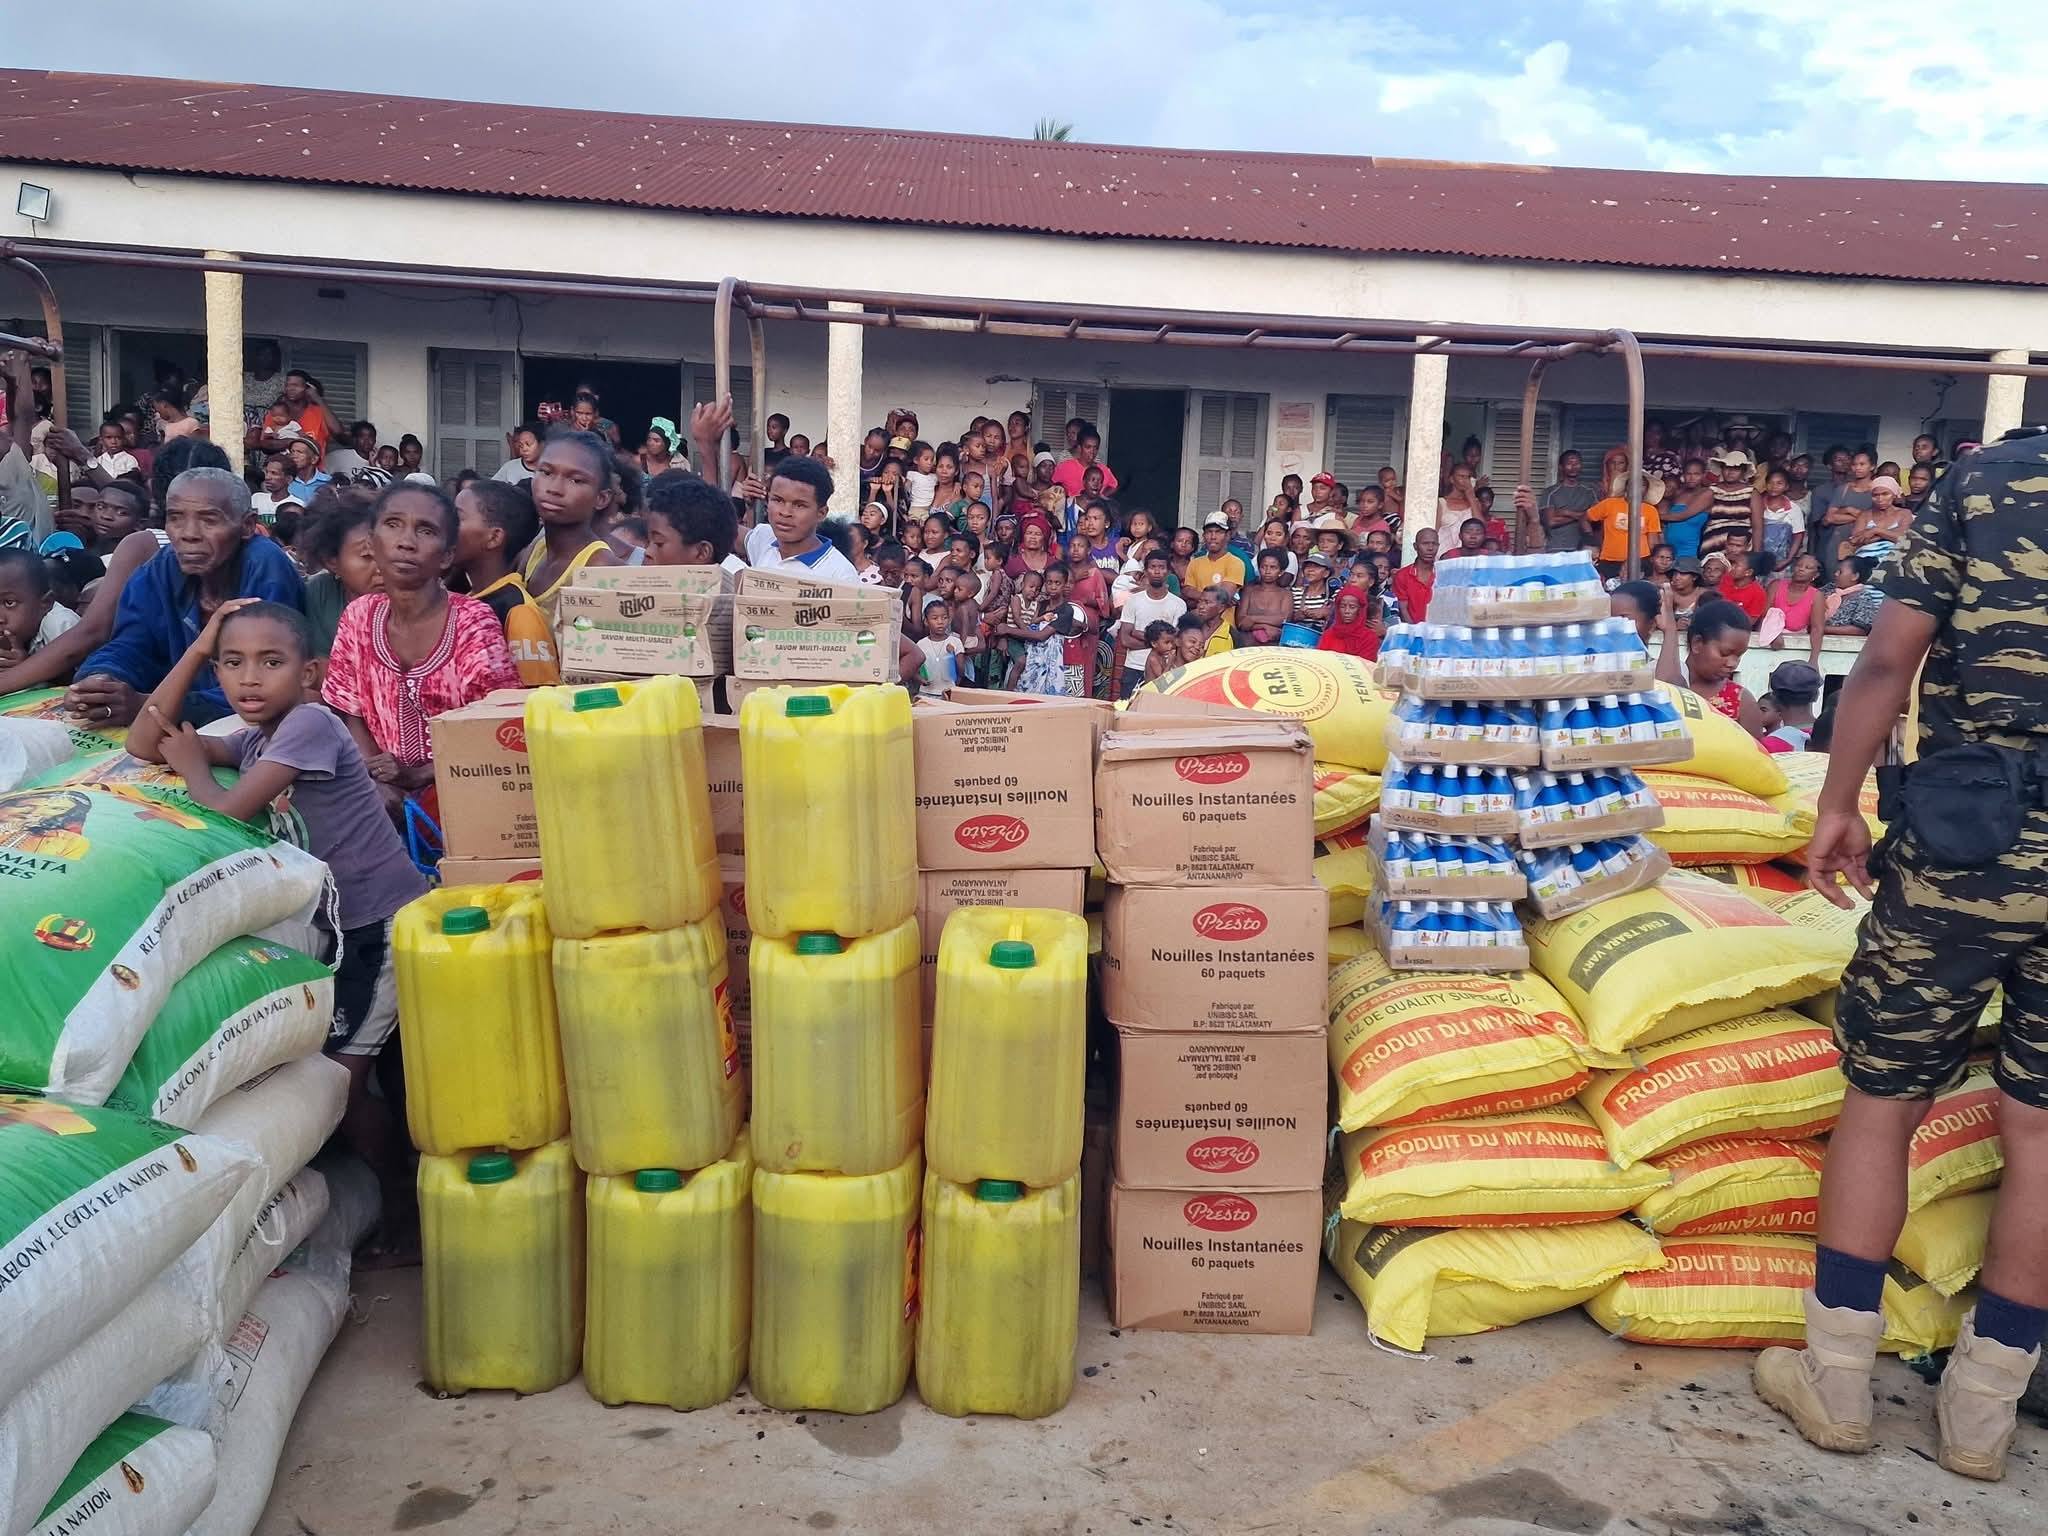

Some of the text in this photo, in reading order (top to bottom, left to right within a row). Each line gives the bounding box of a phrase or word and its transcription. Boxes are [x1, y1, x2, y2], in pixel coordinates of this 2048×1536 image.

[754, 580, 766, 588] 36
[564, 596, 594, 606] 36 Mx
[746, 607, 775, 616] 36 Mx
[601, 633, 624, 642] SAVON
[768, 630, 811, 642] BARRE
[955, 716, 1012, 727] ANTANANARIVO
[944, 728, 990, 737] TALATAMATY
[960, 737, 979, 745] SARL
[449, 763, 512, 779] Nouilles
[1179, 756, 1244, 782] Presto
[501, 781, 516, 792] 60
[954, 775, 1018, 787] 60 paquets
[1007, 789, 1068, 804] Nouilles
[1132, 791, 1297, 807] Nouilles Instantanées
[1657, 790, 1681, 801] DU
[1182, 811, 1247, 824] 60 paquets
[962, 816, 1025, 842] Presto
[1225, 846, 1237, 855] par
[1220, 854, 1240, 862] SARL
[1209, 862, 1255, 871] TALATAMATY
[1186, 871, 1243, 880] ANTANANARIVO
[952, 879, 1008, 887] ANTANANARIVO
[940, 889, 986, 897] TALATAMATY
[1196, 911, 1261, 937] Presto
[139, 937, 158, 956] RIZ
[1603, 930, 1641, 954] TSARA
[1151, 948, 1315, 963] Nouilles Instantanées
[1582, 951, 1607, 977] VARY
[1201, 968, 1266, 981] 60 paquets
[1243, 1003, 1255, 1012] par
[1239, 1012, 1258, 1020] SARL
[1344, 1023, 1365, 1045] RIZ
[1363, 1010, 1385, 1026] DE
[1384, 993, 1446, 1016] QUALITY
[1226, 1020, 1273, 1029] TALATAMATY
[1188, 1045, 1245, 1053] ANTANANARIVO
[1351, 1017, 1472, 1078] PRODUIT DU
[1177, 1055, 1224, 1063] TALATAMATY
[1192, 1064, 1212, 1072] SARL
[1615, 1060, 1708, 1110] PRODUIT
[1708, 1055, 1742, 1074] DU
[1185, 1101, 1248, 1113] 60 paquets
[1135, 1116, 1297, 1131] Nouilles Instantanées
[1193, 1139, 1256, 1165] Presto
[1371, 1133, 1461, 1166] PRODUIT
[1468, 1133, 1499, 1148] DU
[47, 1222, 70, 1241] LE
[113, 1181, 133, 1199] LA
[128, 1159, 169, 1188] NATION
[1187, 1201, 1251, 1227] Presto
[1790, 1210, 1817, 1226] DU
[1142, 1236, 1304, 1253] Nouilles Instantanées
[1370, 1230, 1396, 1260] VARY
[1191, 1256, 1255, 1270] 60 paquets
[1732, 1255, 1762, 1272] DU
[1233, 1293, 1244, 1301] par
[1228, 1301, 1247, 1309] SARL
[1216, 1310, 1261, 1318] TALATAMATY
[1193, 1318, 1250, 1326] ANTANANARIVO
[65, 1487, 112, 1531] NATION
